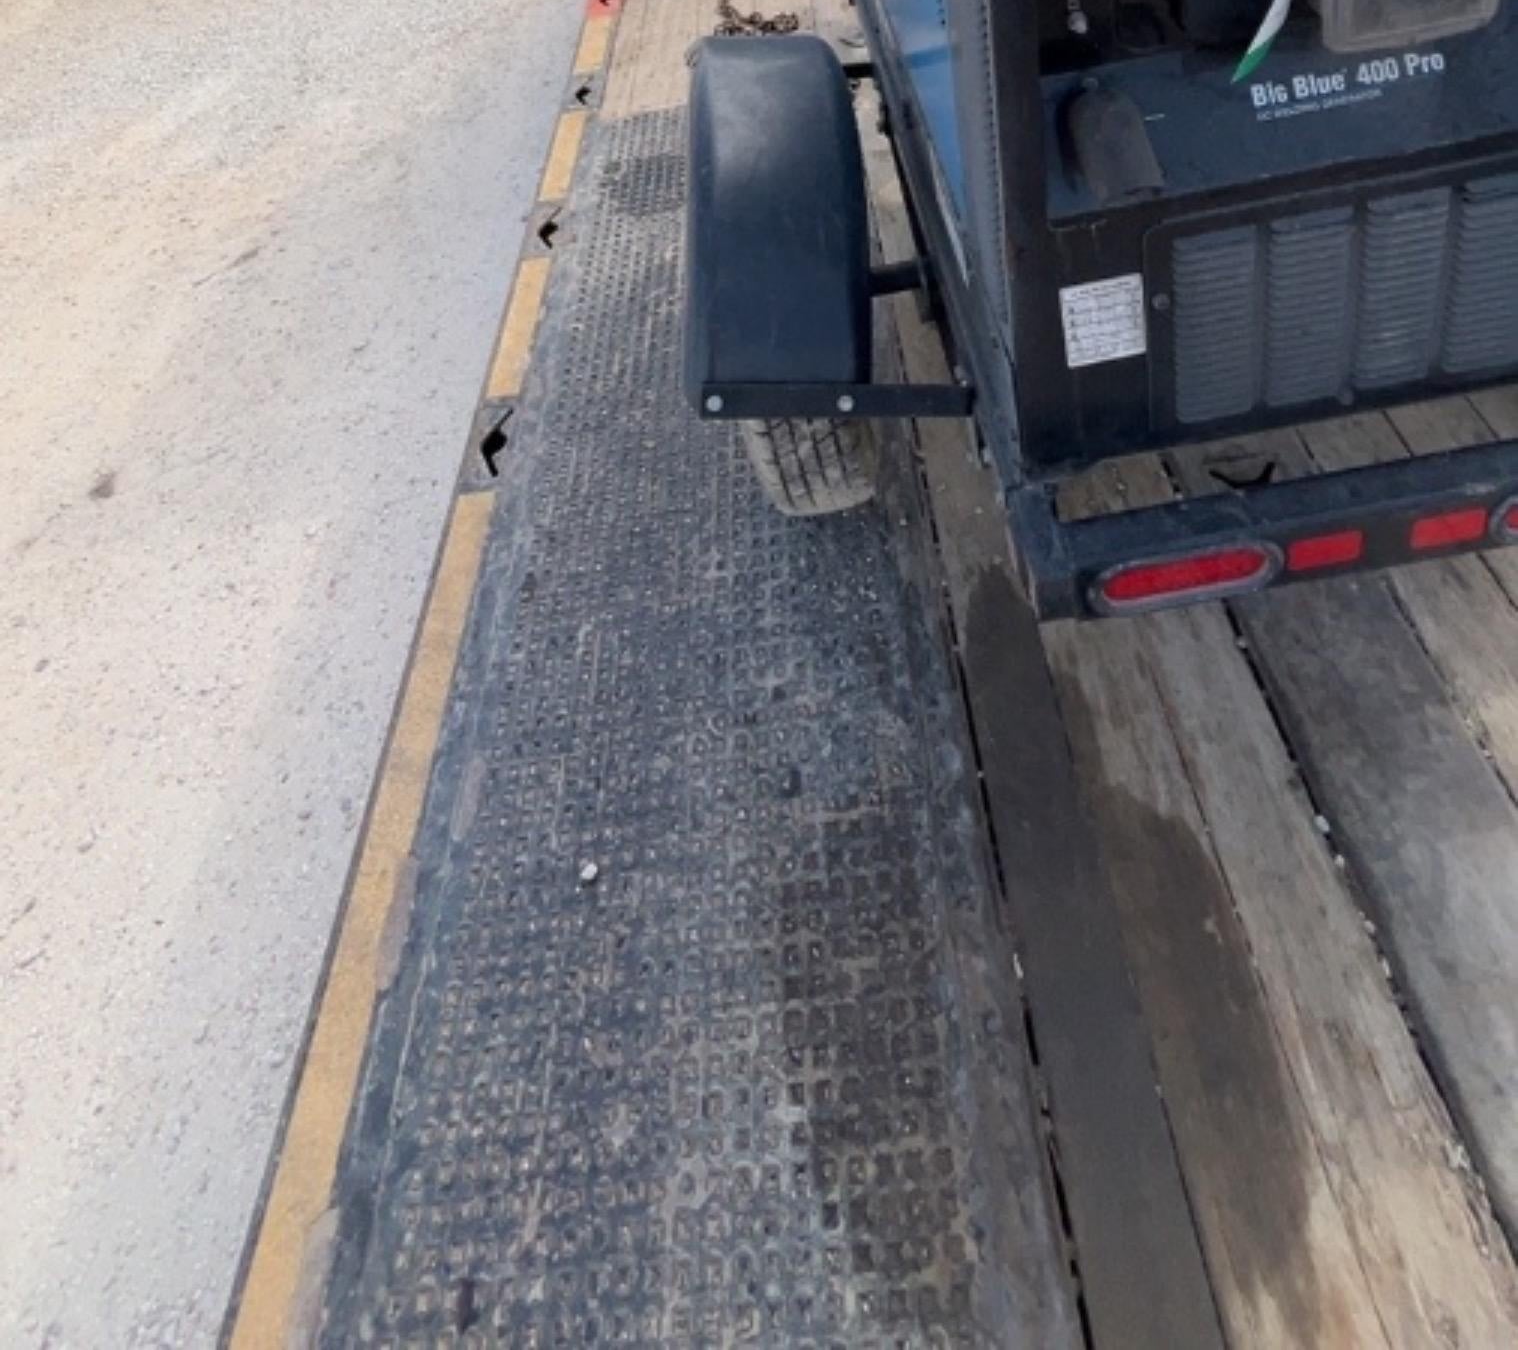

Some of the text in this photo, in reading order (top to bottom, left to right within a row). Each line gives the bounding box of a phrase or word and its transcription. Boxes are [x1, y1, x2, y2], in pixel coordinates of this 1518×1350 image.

[1292, 72, 1346, 99] Blue
[1356, 56, 1399, 85] 400
[1403, 52, 1445, 76] Pro
